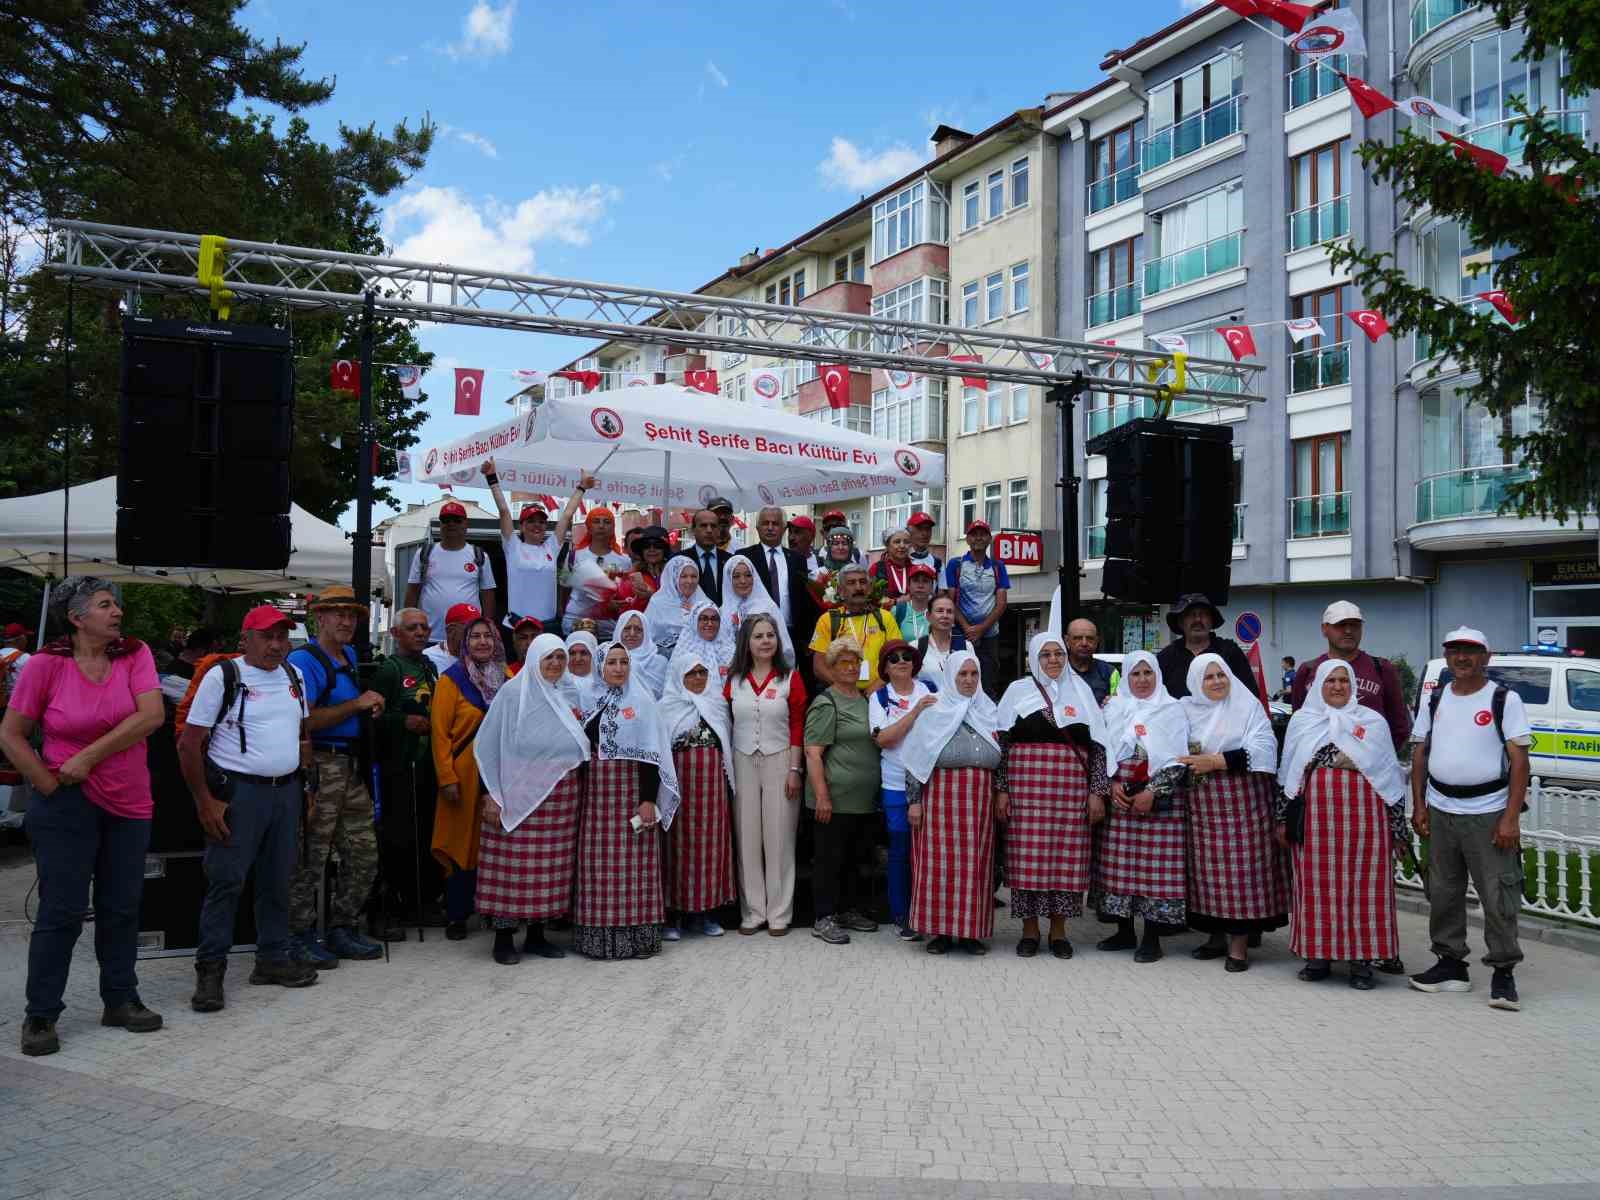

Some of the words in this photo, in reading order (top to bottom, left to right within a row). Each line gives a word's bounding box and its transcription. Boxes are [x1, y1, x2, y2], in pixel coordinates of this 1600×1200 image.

[644, 422, 693, 441] Şehit
[698, 429, 750, 450] Şerife
[755, 437, 793, 455] Bacı
[798, 442, 849, 463] Kültür
[853, 450, 878, 465] Evi
[1000, 535, 1039, 560] BİM
